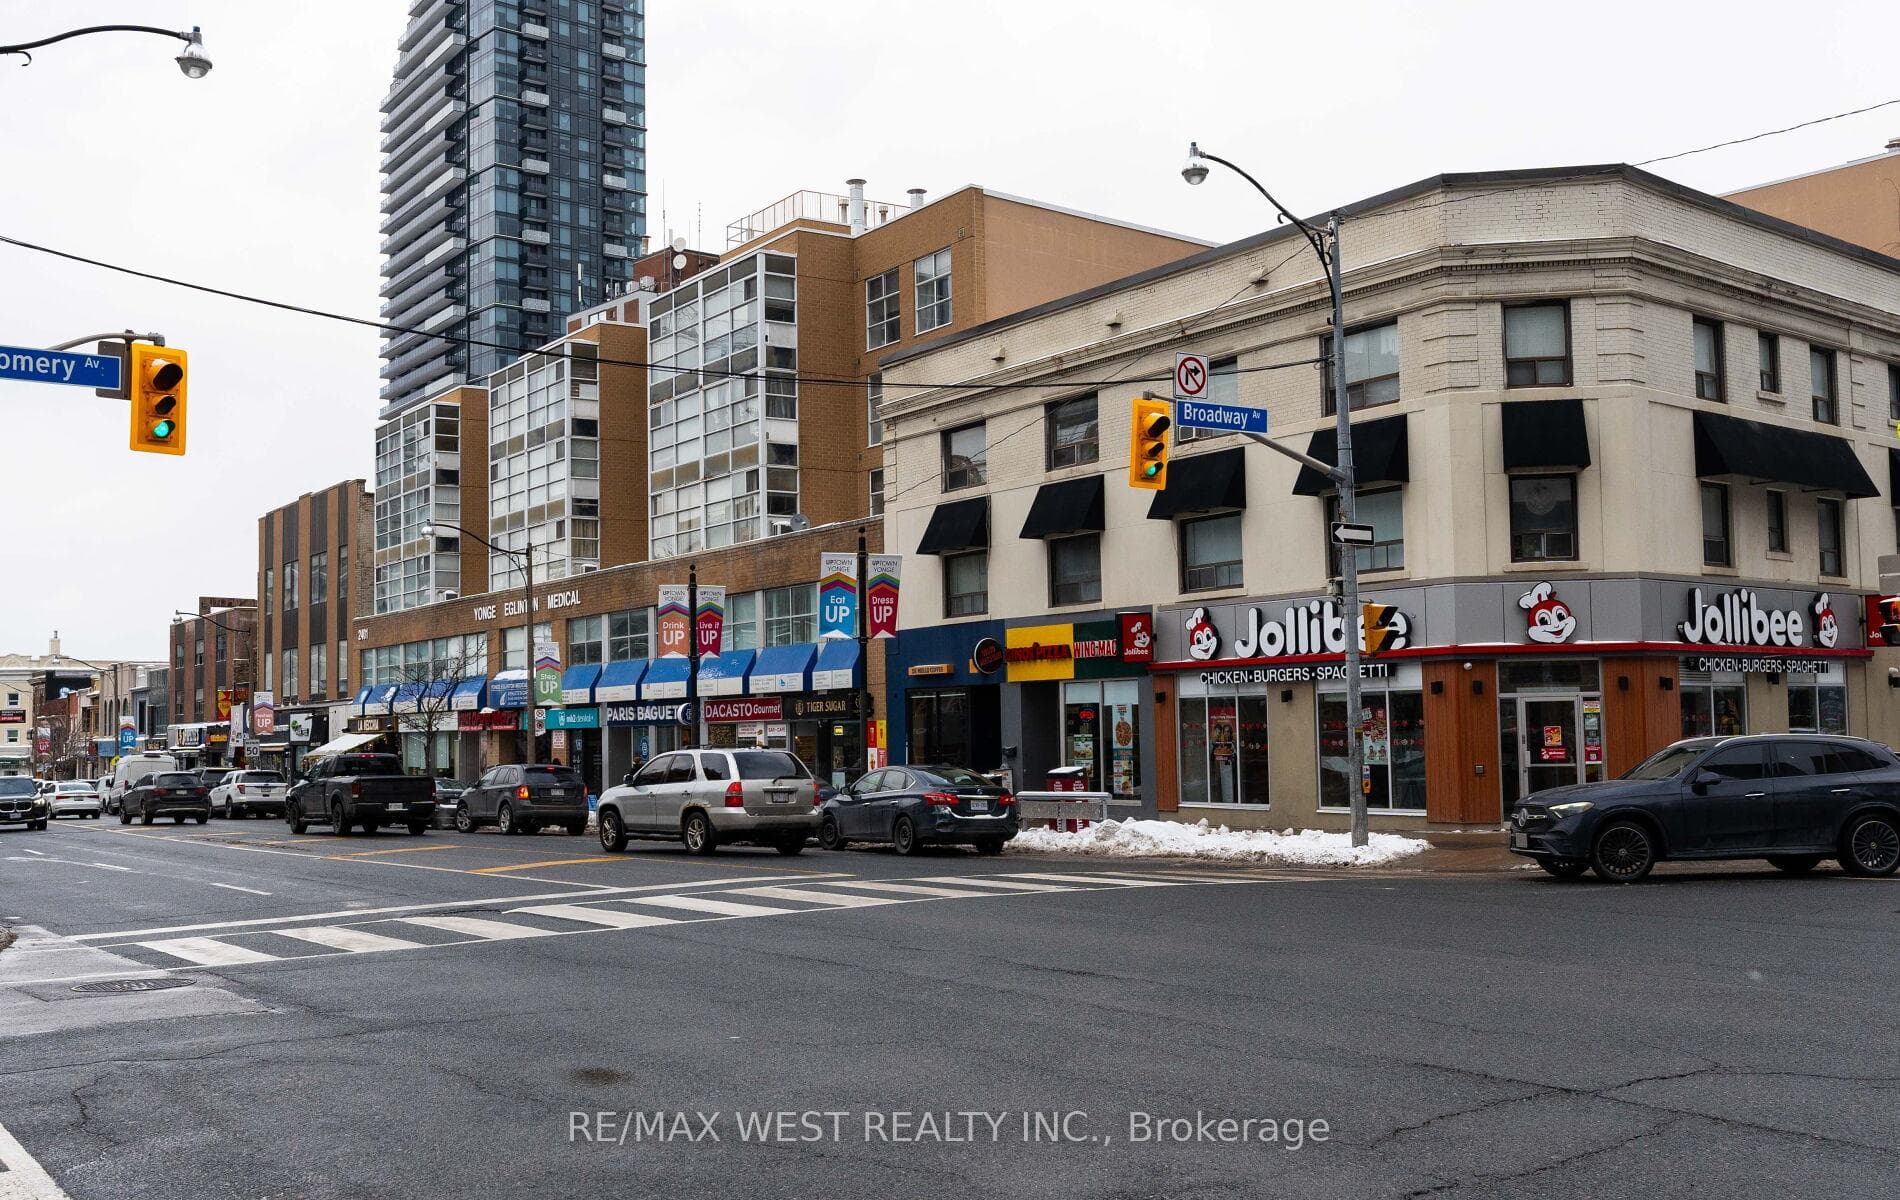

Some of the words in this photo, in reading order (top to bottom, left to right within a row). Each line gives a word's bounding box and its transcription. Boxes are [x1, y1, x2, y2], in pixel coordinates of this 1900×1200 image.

[0, 353, 75, 381] omery
[84, 357, 99, 368] Av
[1184, 403, 1248, 429] Broadway
[1252, 410, 1261, 419] Av
[474, 605, 496, 620] YONGE
[504, 597, 539, 616] EGLINTN
[547, 591, 581, 609] MEDICAL
[830, 595, 846, 604] Eat
[872, 596, 894, 604] Dress
[825, 605, 850, 623] UP
[873, 606, 893, 623] UP
[1684, 587, 1803, 646] Jollibee
[663, 621, 685, 629] Drink
[663, 630, 685, 645] UP
[701, 630, 718, 645] UP
[1124, 647, 1149, 656] Jollibee
[1699, 657, 1739, 672] CHICKEN
[1742, 659, 1782, 673] BURGERS
[1786, 660, 1830, 674] SPAGHETTI
[540, 673, 556, 681] Step
[1200, 671, 1248, 684] CHICKEN
[1254, 668, 1310, 682] BURGERS
[1316, 664, 1388, 679] SPAGETTI
[540, 681, 558, 694] UP
[607, 706, 635, 721] PARIS
[637, 705, 679, 720] BAGUET
[705, 703, 752, 718] DACASTO
[753, 704, 780, 715] Gourmet
[807, 701, 824, 712] TIGER
[825, 700, 846, 711] SUGAR
[257, 719, 271, 728] UP
[123, 735, 134, 743] UP
[246, 746, 258, 755] 50
